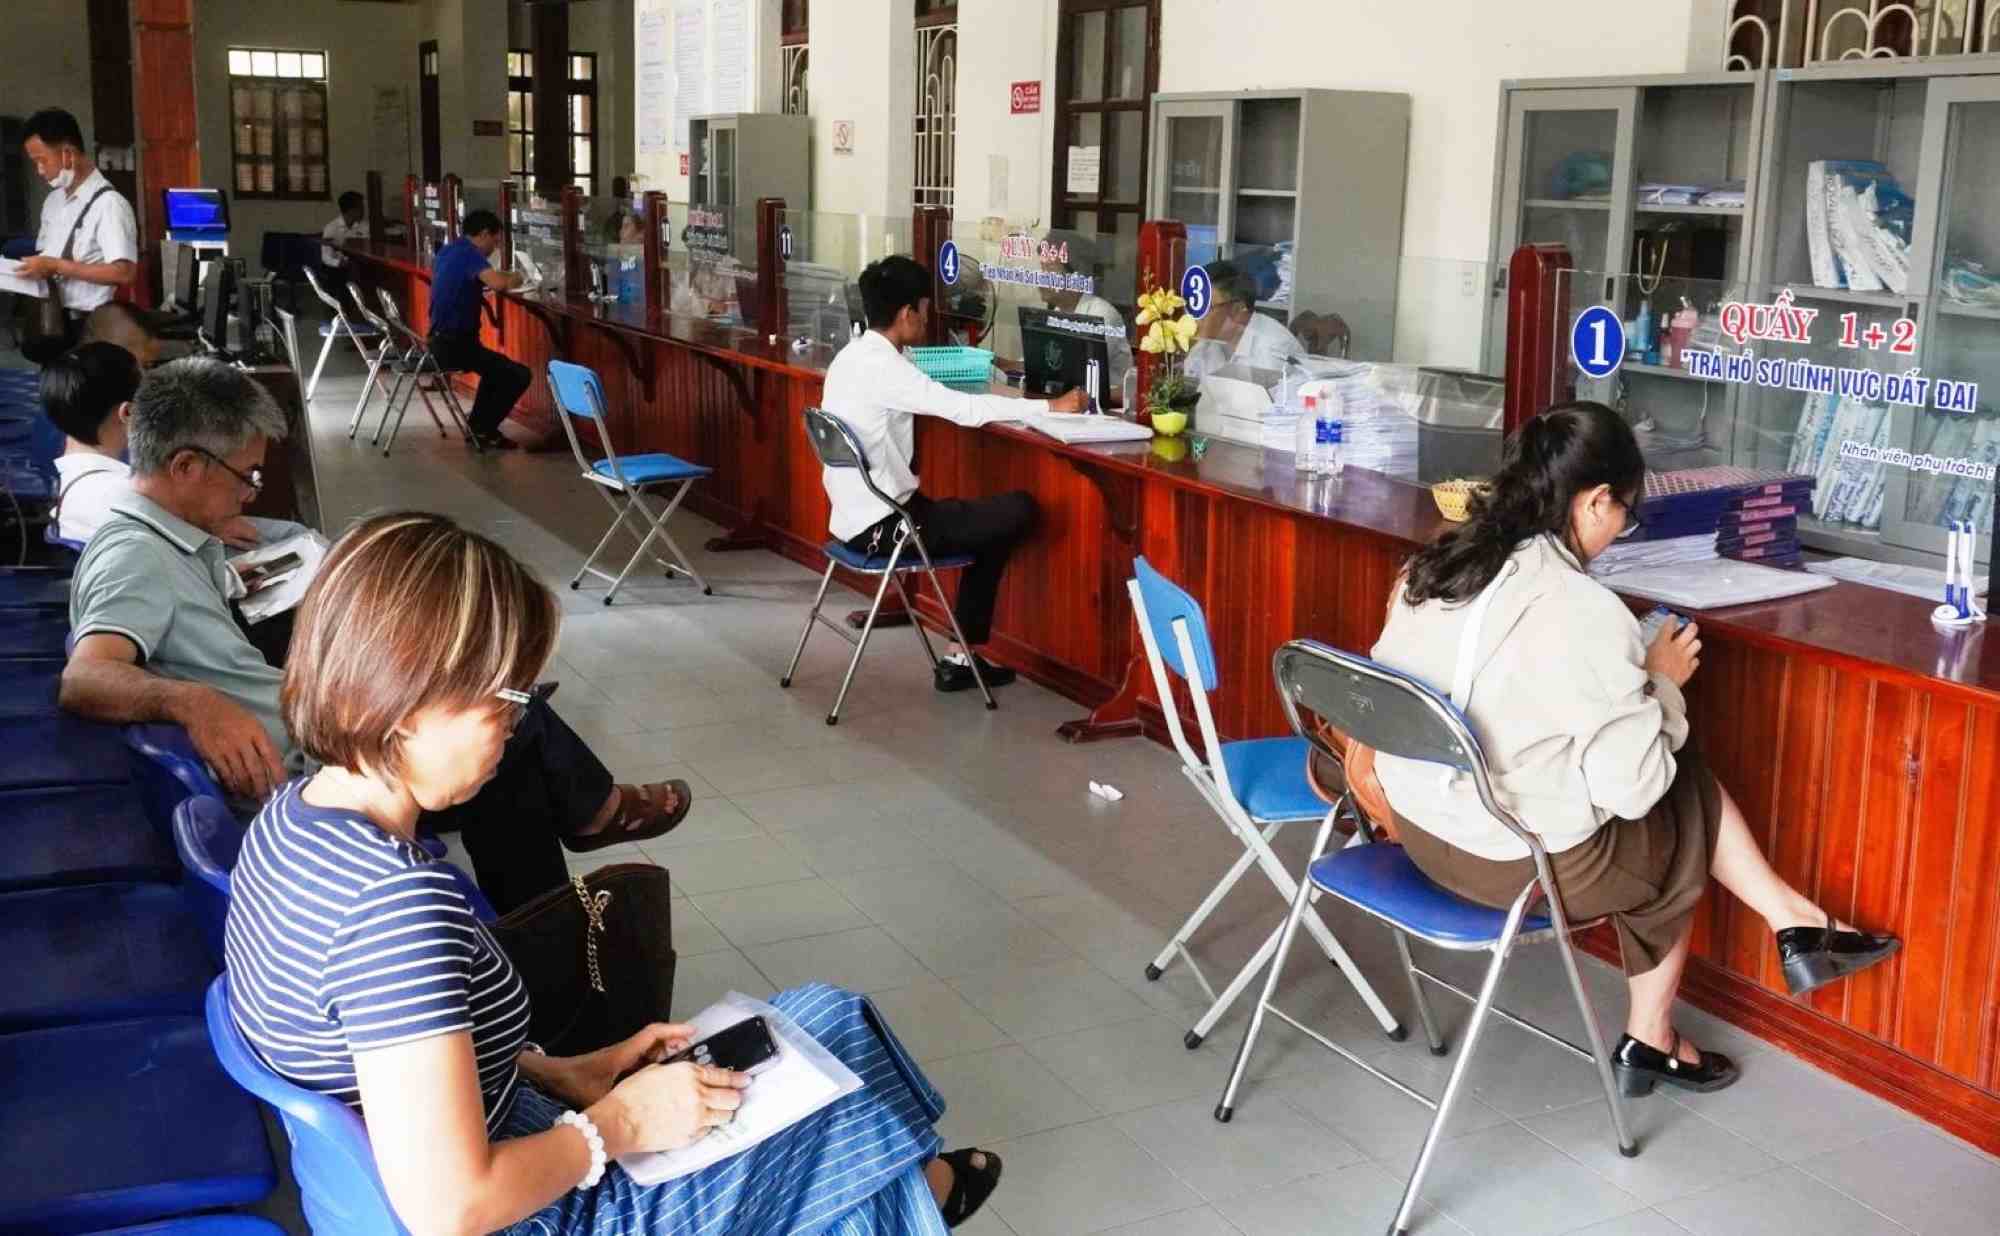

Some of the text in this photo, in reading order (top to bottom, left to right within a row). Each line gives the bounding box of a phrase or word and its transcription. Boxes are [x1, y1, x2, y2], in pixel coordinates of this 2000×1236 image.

[944, 249, 956, 278] 4
[1190, 273, 1205, 312] 3
[1588, 318, 1610, 366] 1
[1721, 289, 1917, 354] QUẦY 1+2
[1727, 348, 1754, 383] HỒ
[1757, 356, 1786, 387] SƠ
[1787, 358, 1835, 395] LĨNH
[1838, 368, 1881, 404] VỰC
[1885, 368, 1930, 407] ĐẤT
[1935, 379, 1978, 413] ĐAI
